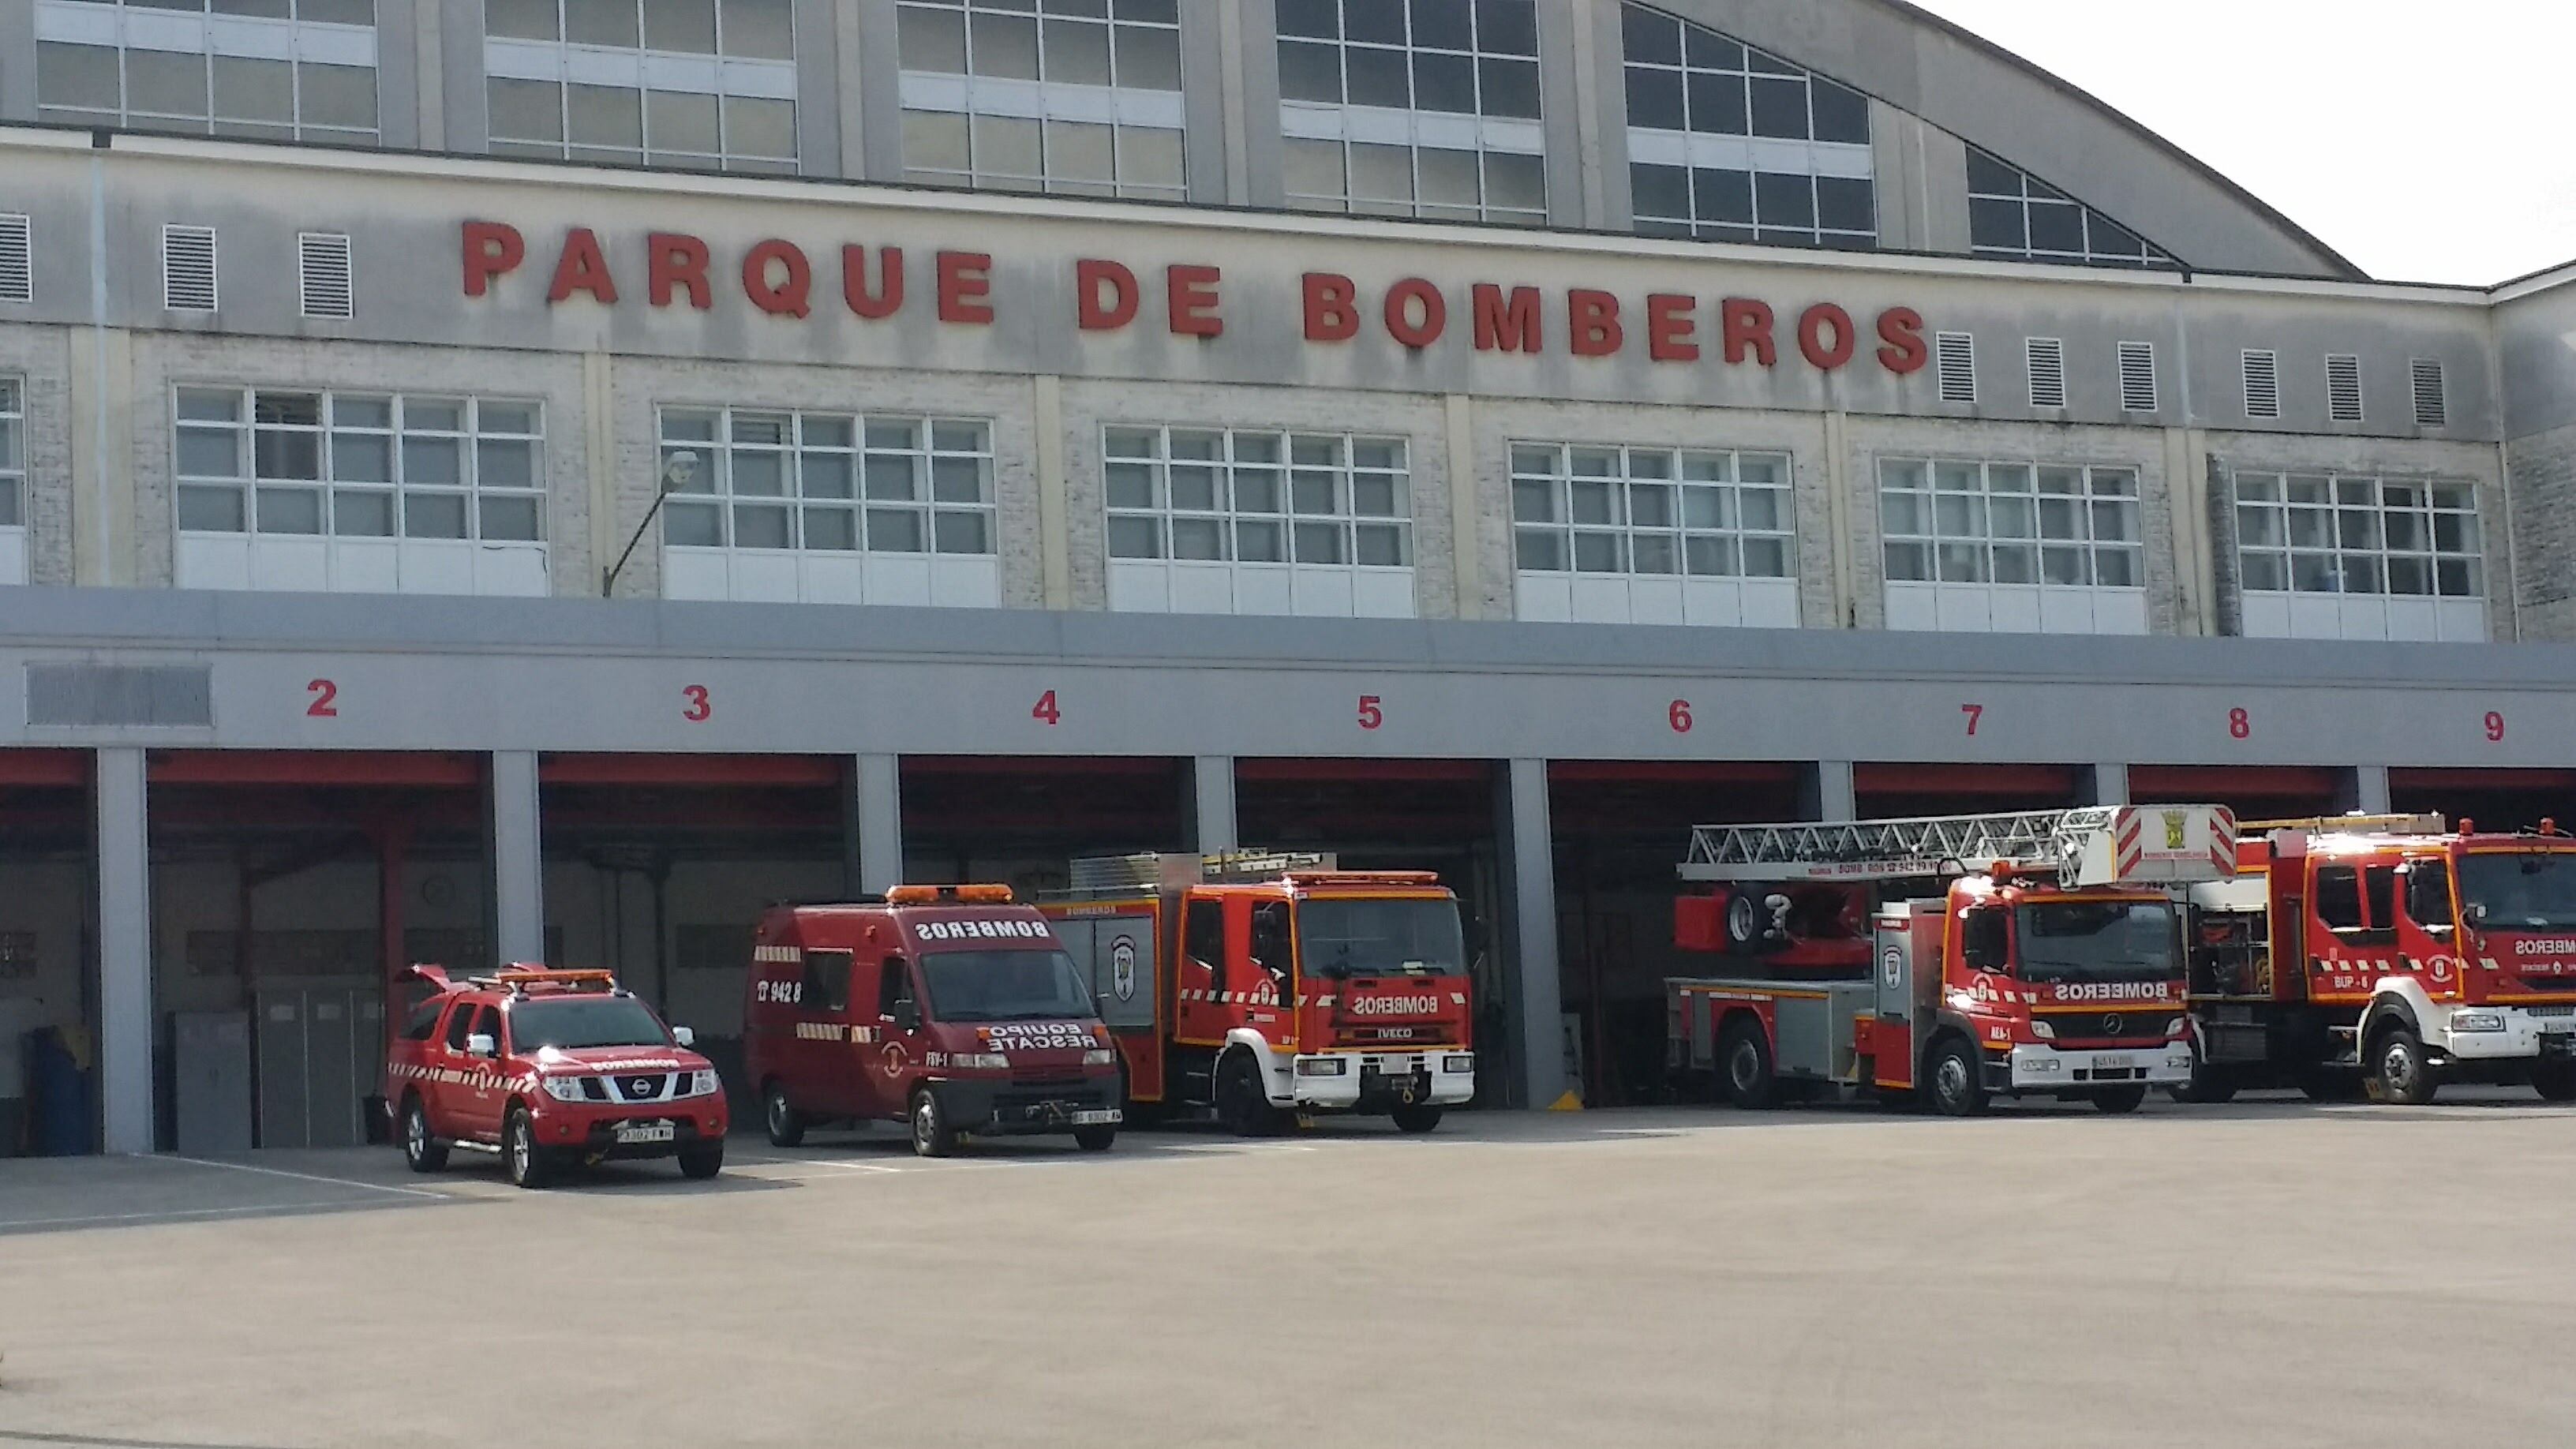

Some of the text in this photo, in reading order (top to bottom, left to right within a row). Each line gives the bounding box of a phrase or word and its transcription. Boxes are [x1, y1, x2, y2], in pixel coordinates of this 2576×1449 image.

[462, 222, 1927, 375] PARQUE DE BOMBEROS
[307, 680, 337, 717] 2
[684, 686, 711, 721] 3
[1033, 691, 1059, 724] 4
[1358, 697, 1382, 730] 5
[1668, 700, 1691, 733] 6
[1962, 704, 1983, 735] 7
[2230, 709, 2250, 739] 8
[2485, 712, 2504, 741] 9
[1377, 1028, 1413, 1039] IVECO
